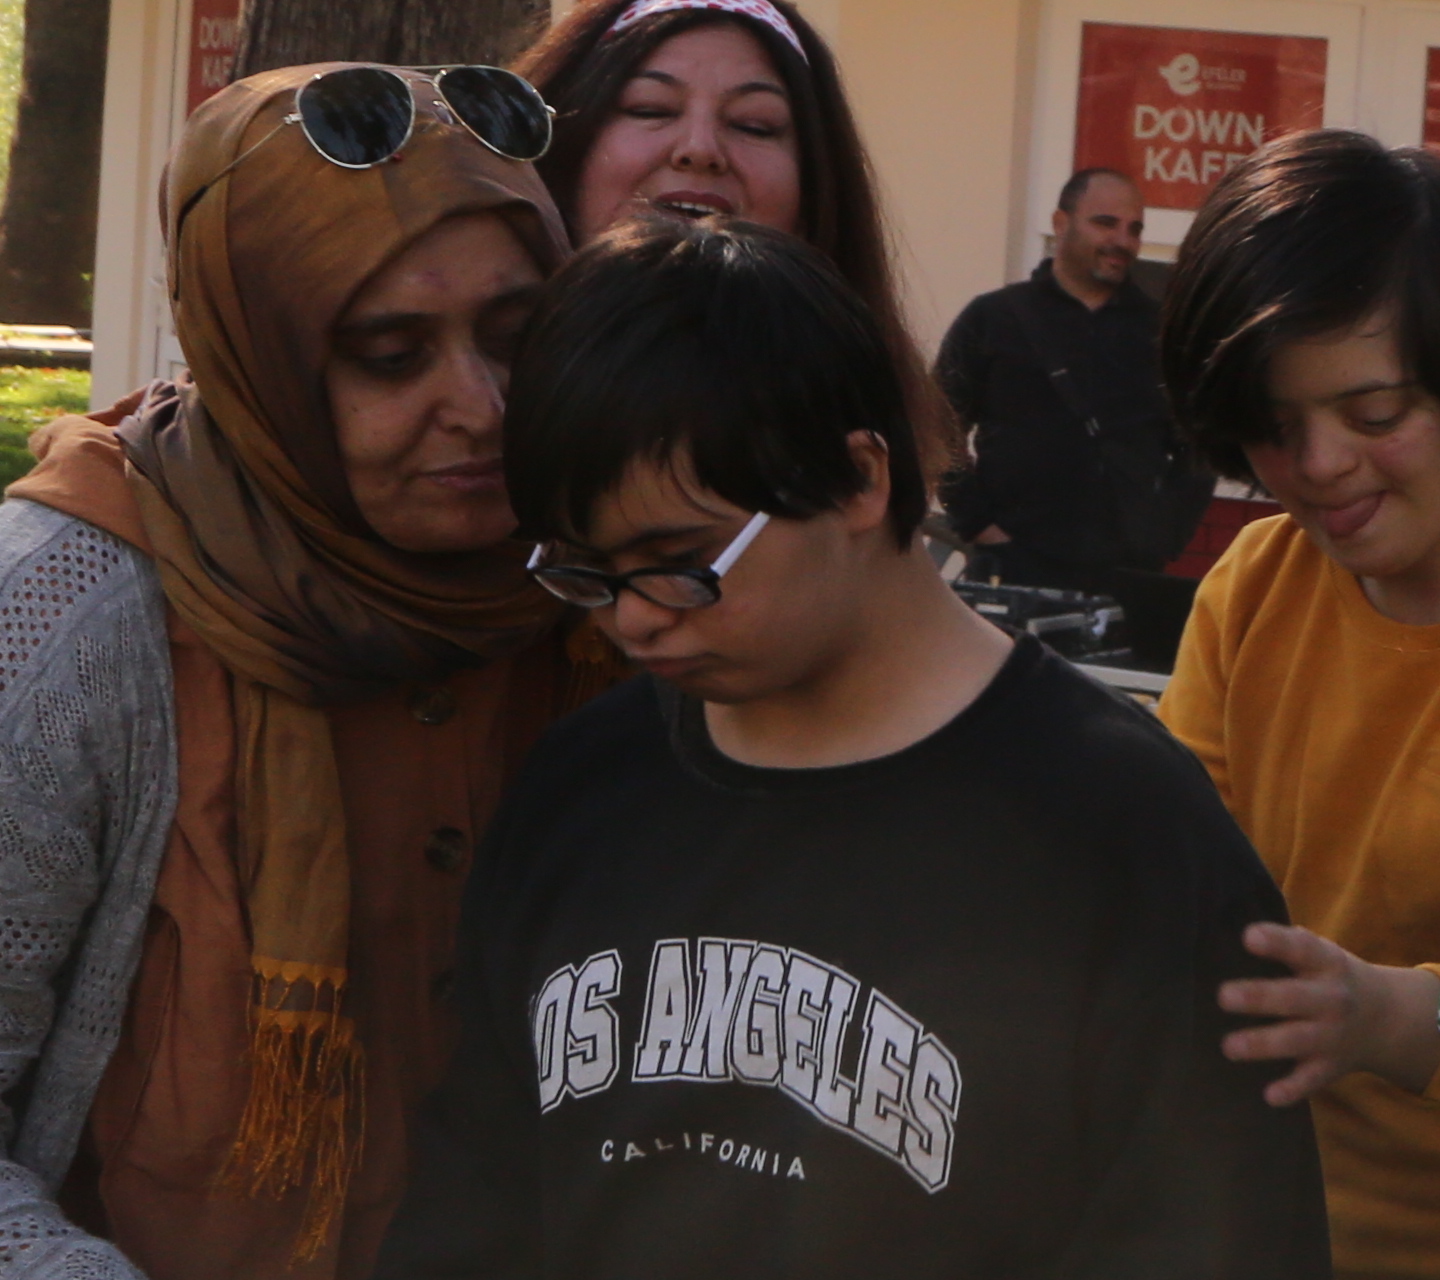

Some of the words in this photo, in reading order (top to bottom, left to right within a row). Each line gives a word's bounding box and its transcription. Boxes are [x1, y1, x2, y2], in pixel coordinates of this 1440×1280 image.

[1134, 104, 1265, 147] DOWN
[530, 948, 624, 1115] OS
[630, 936, 963, 1195] ANGELES
[601, 1131, 806, 1180] CALIFORNIA
